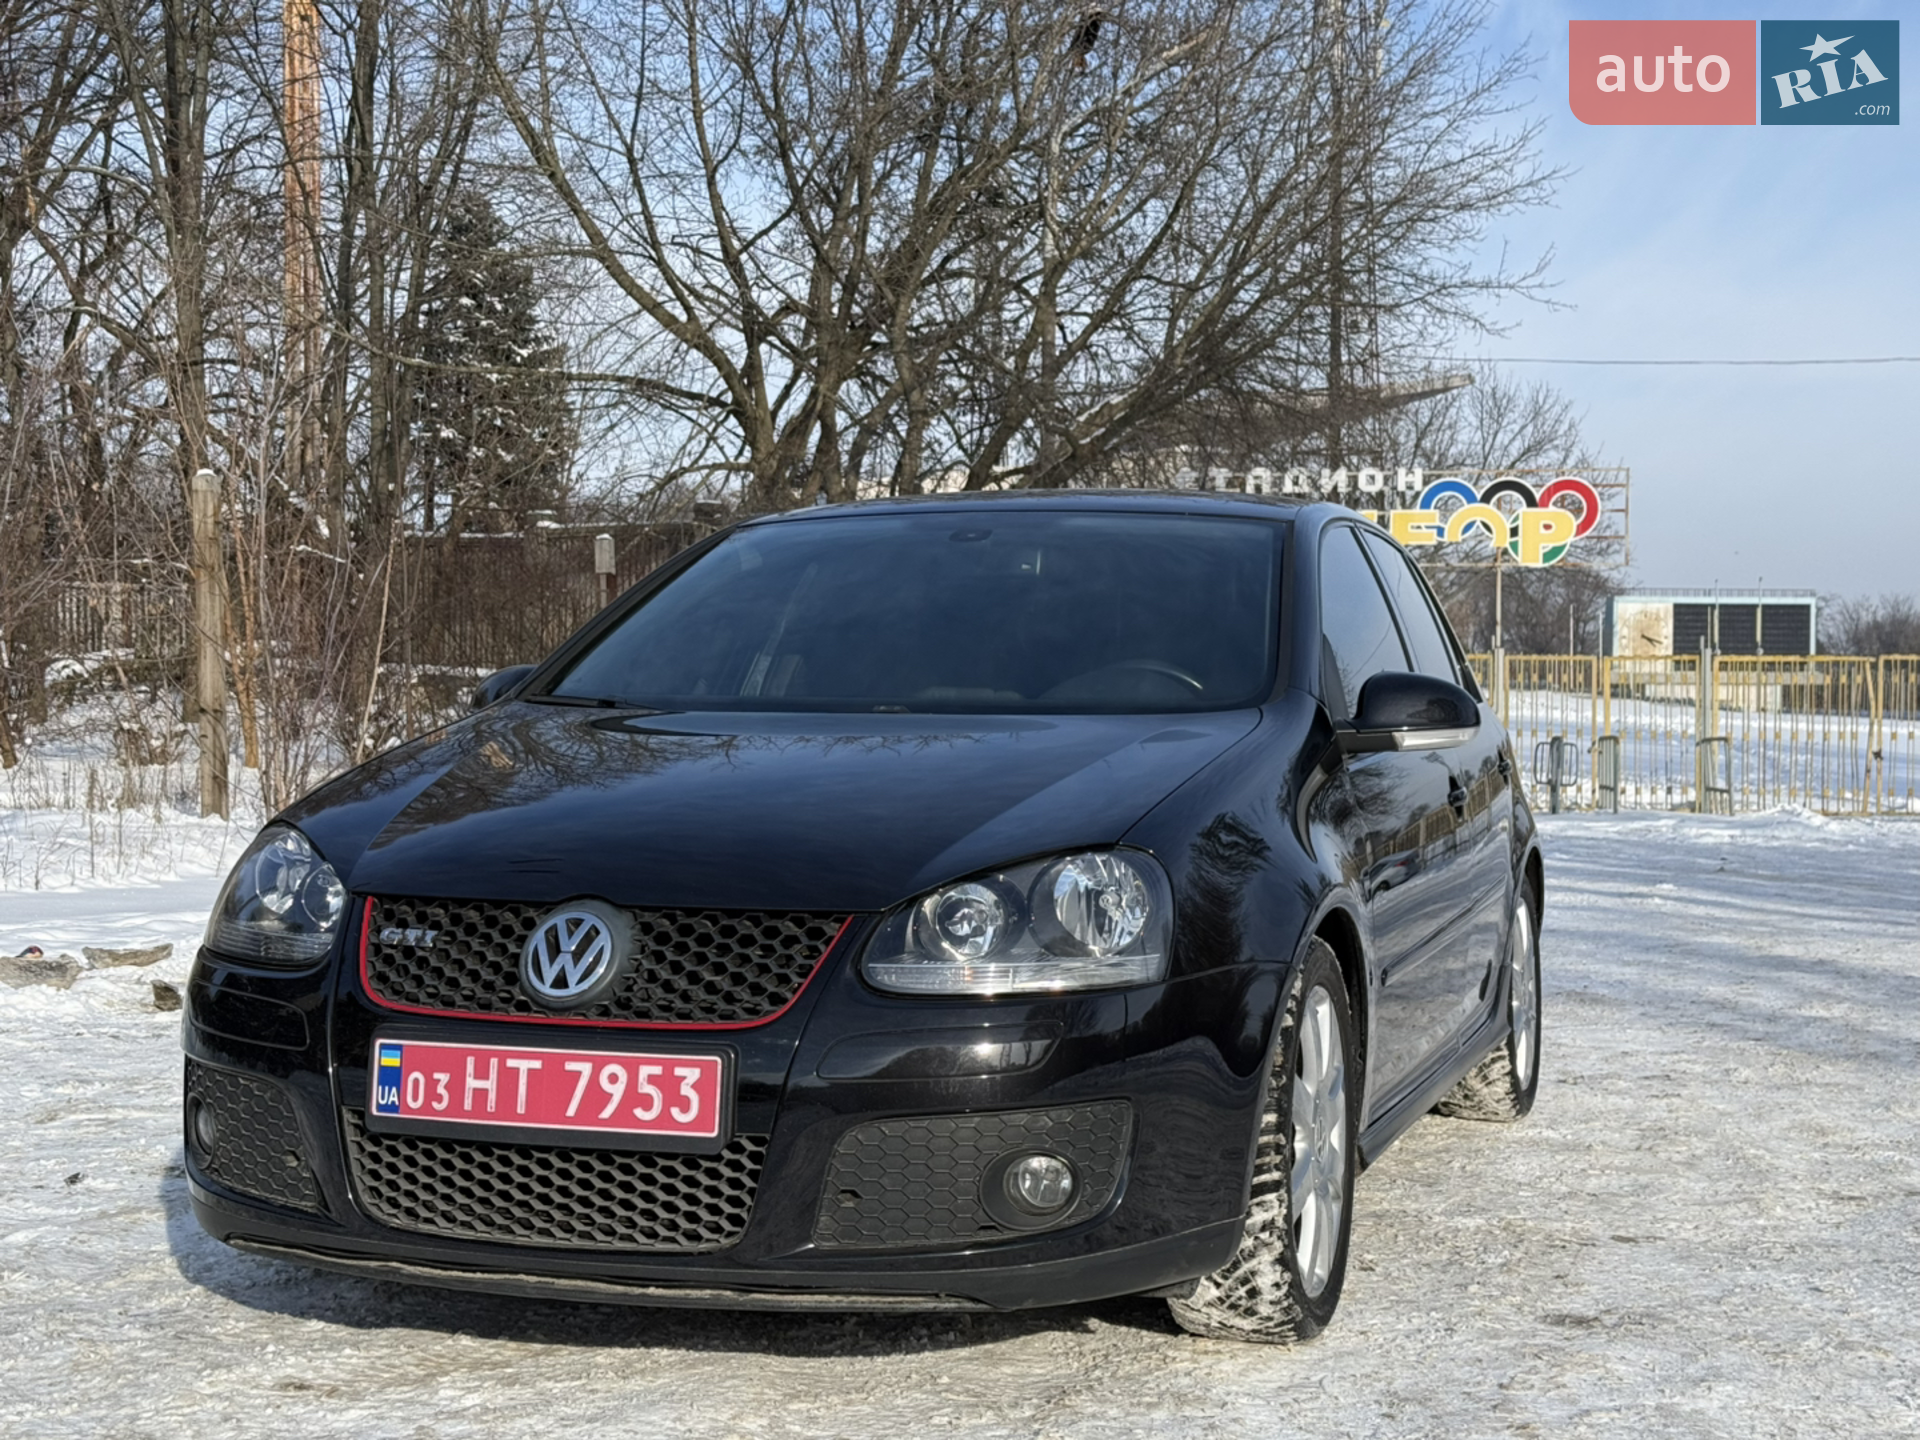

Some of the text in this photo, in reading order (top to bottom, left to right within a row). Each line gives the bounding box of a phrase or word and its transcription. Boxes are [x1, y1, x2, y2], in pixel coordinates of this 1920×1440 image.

[379, 927, 439, 947] GTI
[378, 1085, 399, 1105] UA
[406, 1056, 702, 1123] 03 HT 7953
